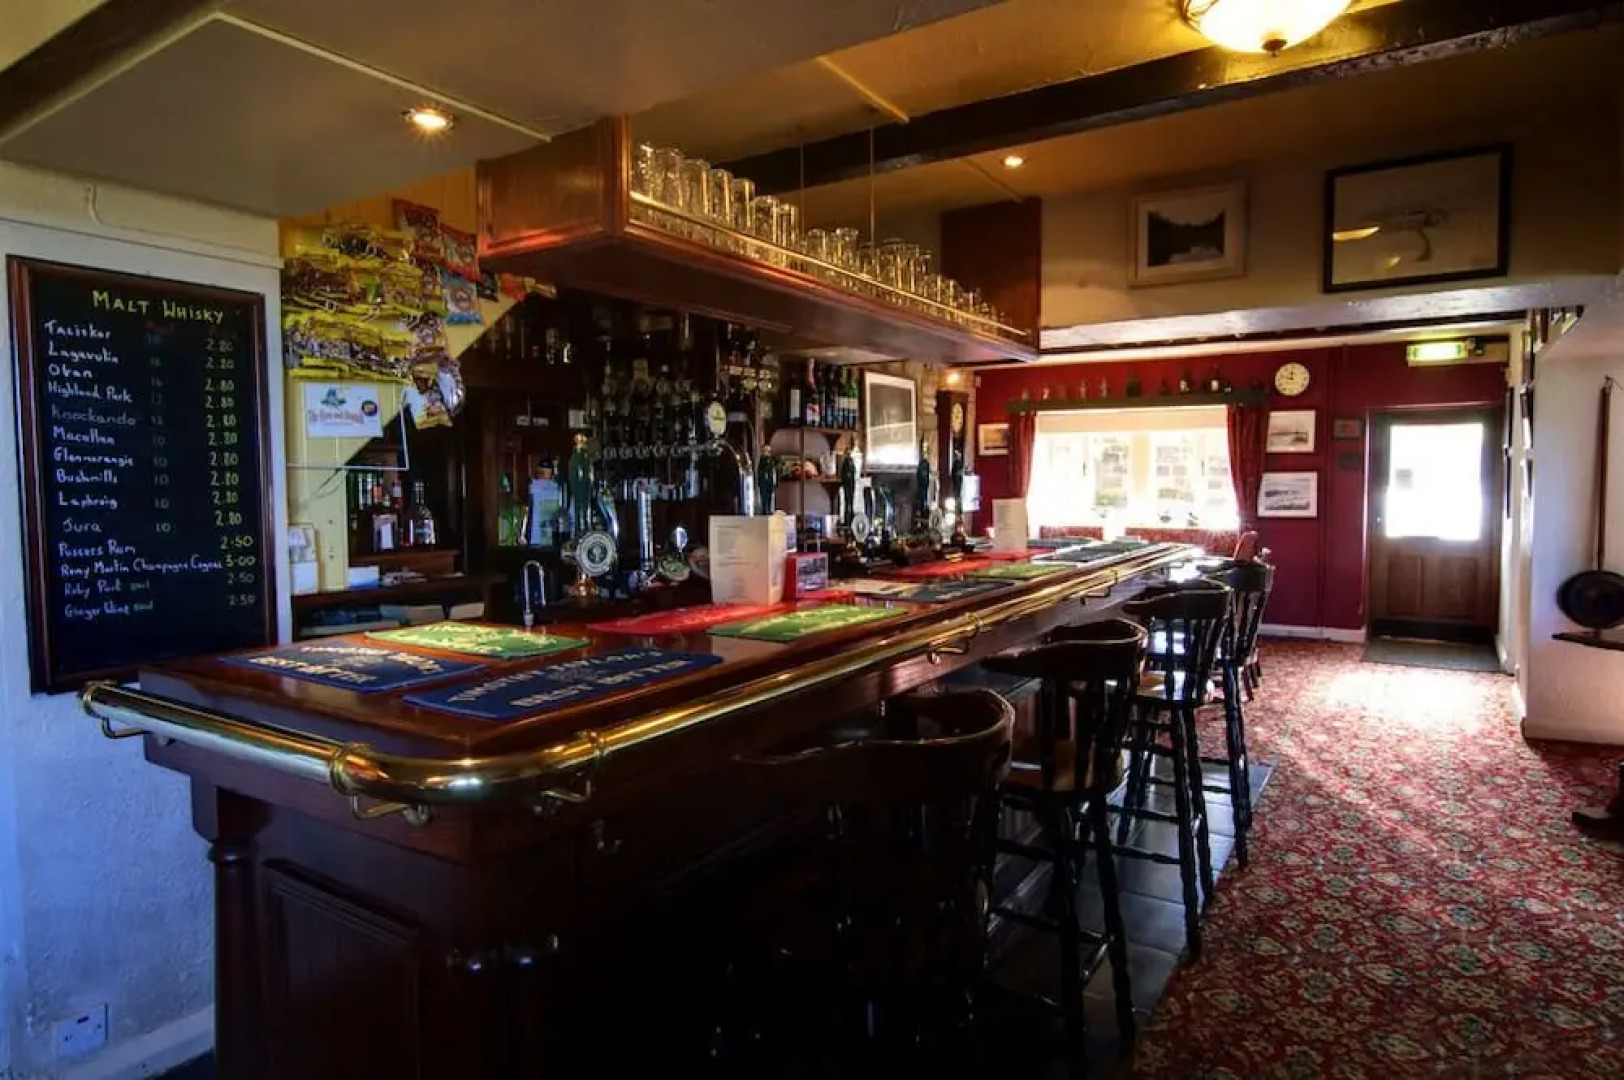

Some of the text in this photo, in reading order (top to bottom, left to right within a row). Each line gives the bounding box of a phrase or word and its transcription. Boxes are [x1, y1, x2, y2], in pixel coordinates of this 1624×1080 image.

[92, 290, 149, 313] MALT
[63, 517, 102, 532] Jura
[108, 538, 136, 554] Rum
